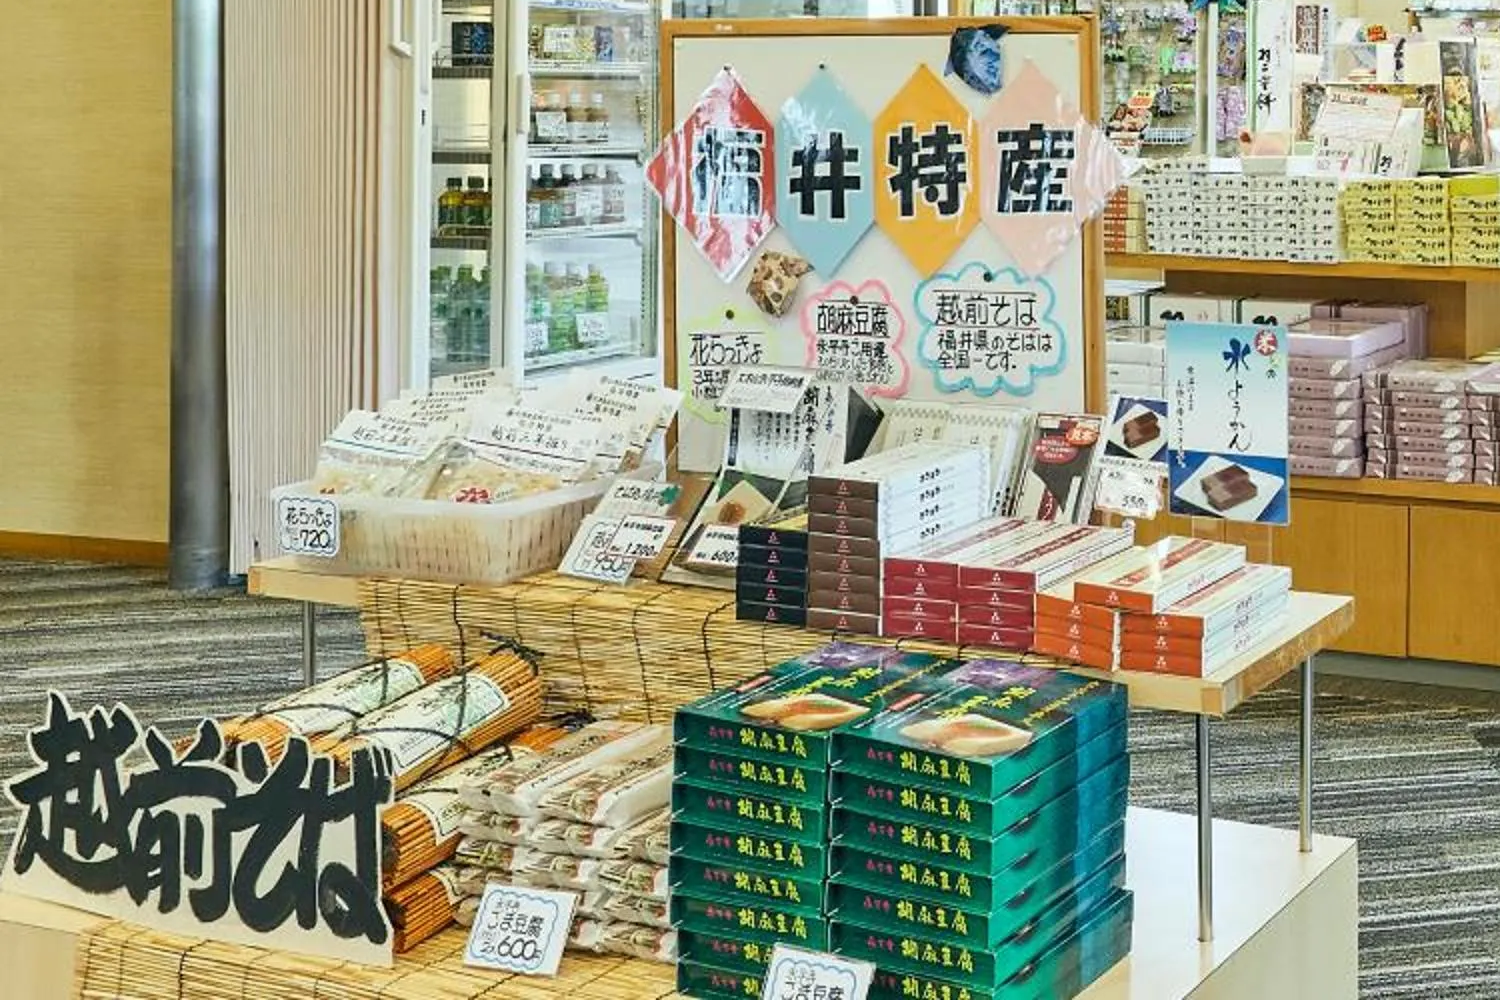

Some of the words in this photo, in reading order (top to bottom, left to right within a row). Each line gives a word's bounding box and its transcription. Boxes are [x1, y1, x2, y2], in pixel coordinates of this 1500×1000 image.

[692, 123, 1075, 219] 福井特産
[690, 335, 763, 366] 花らっきょ
[817, 303, 889, 336] 胡麻豆腐
[1222, 337, 1252, 451] 水ようかん
[10, 691, 393, 944] 越前そば
